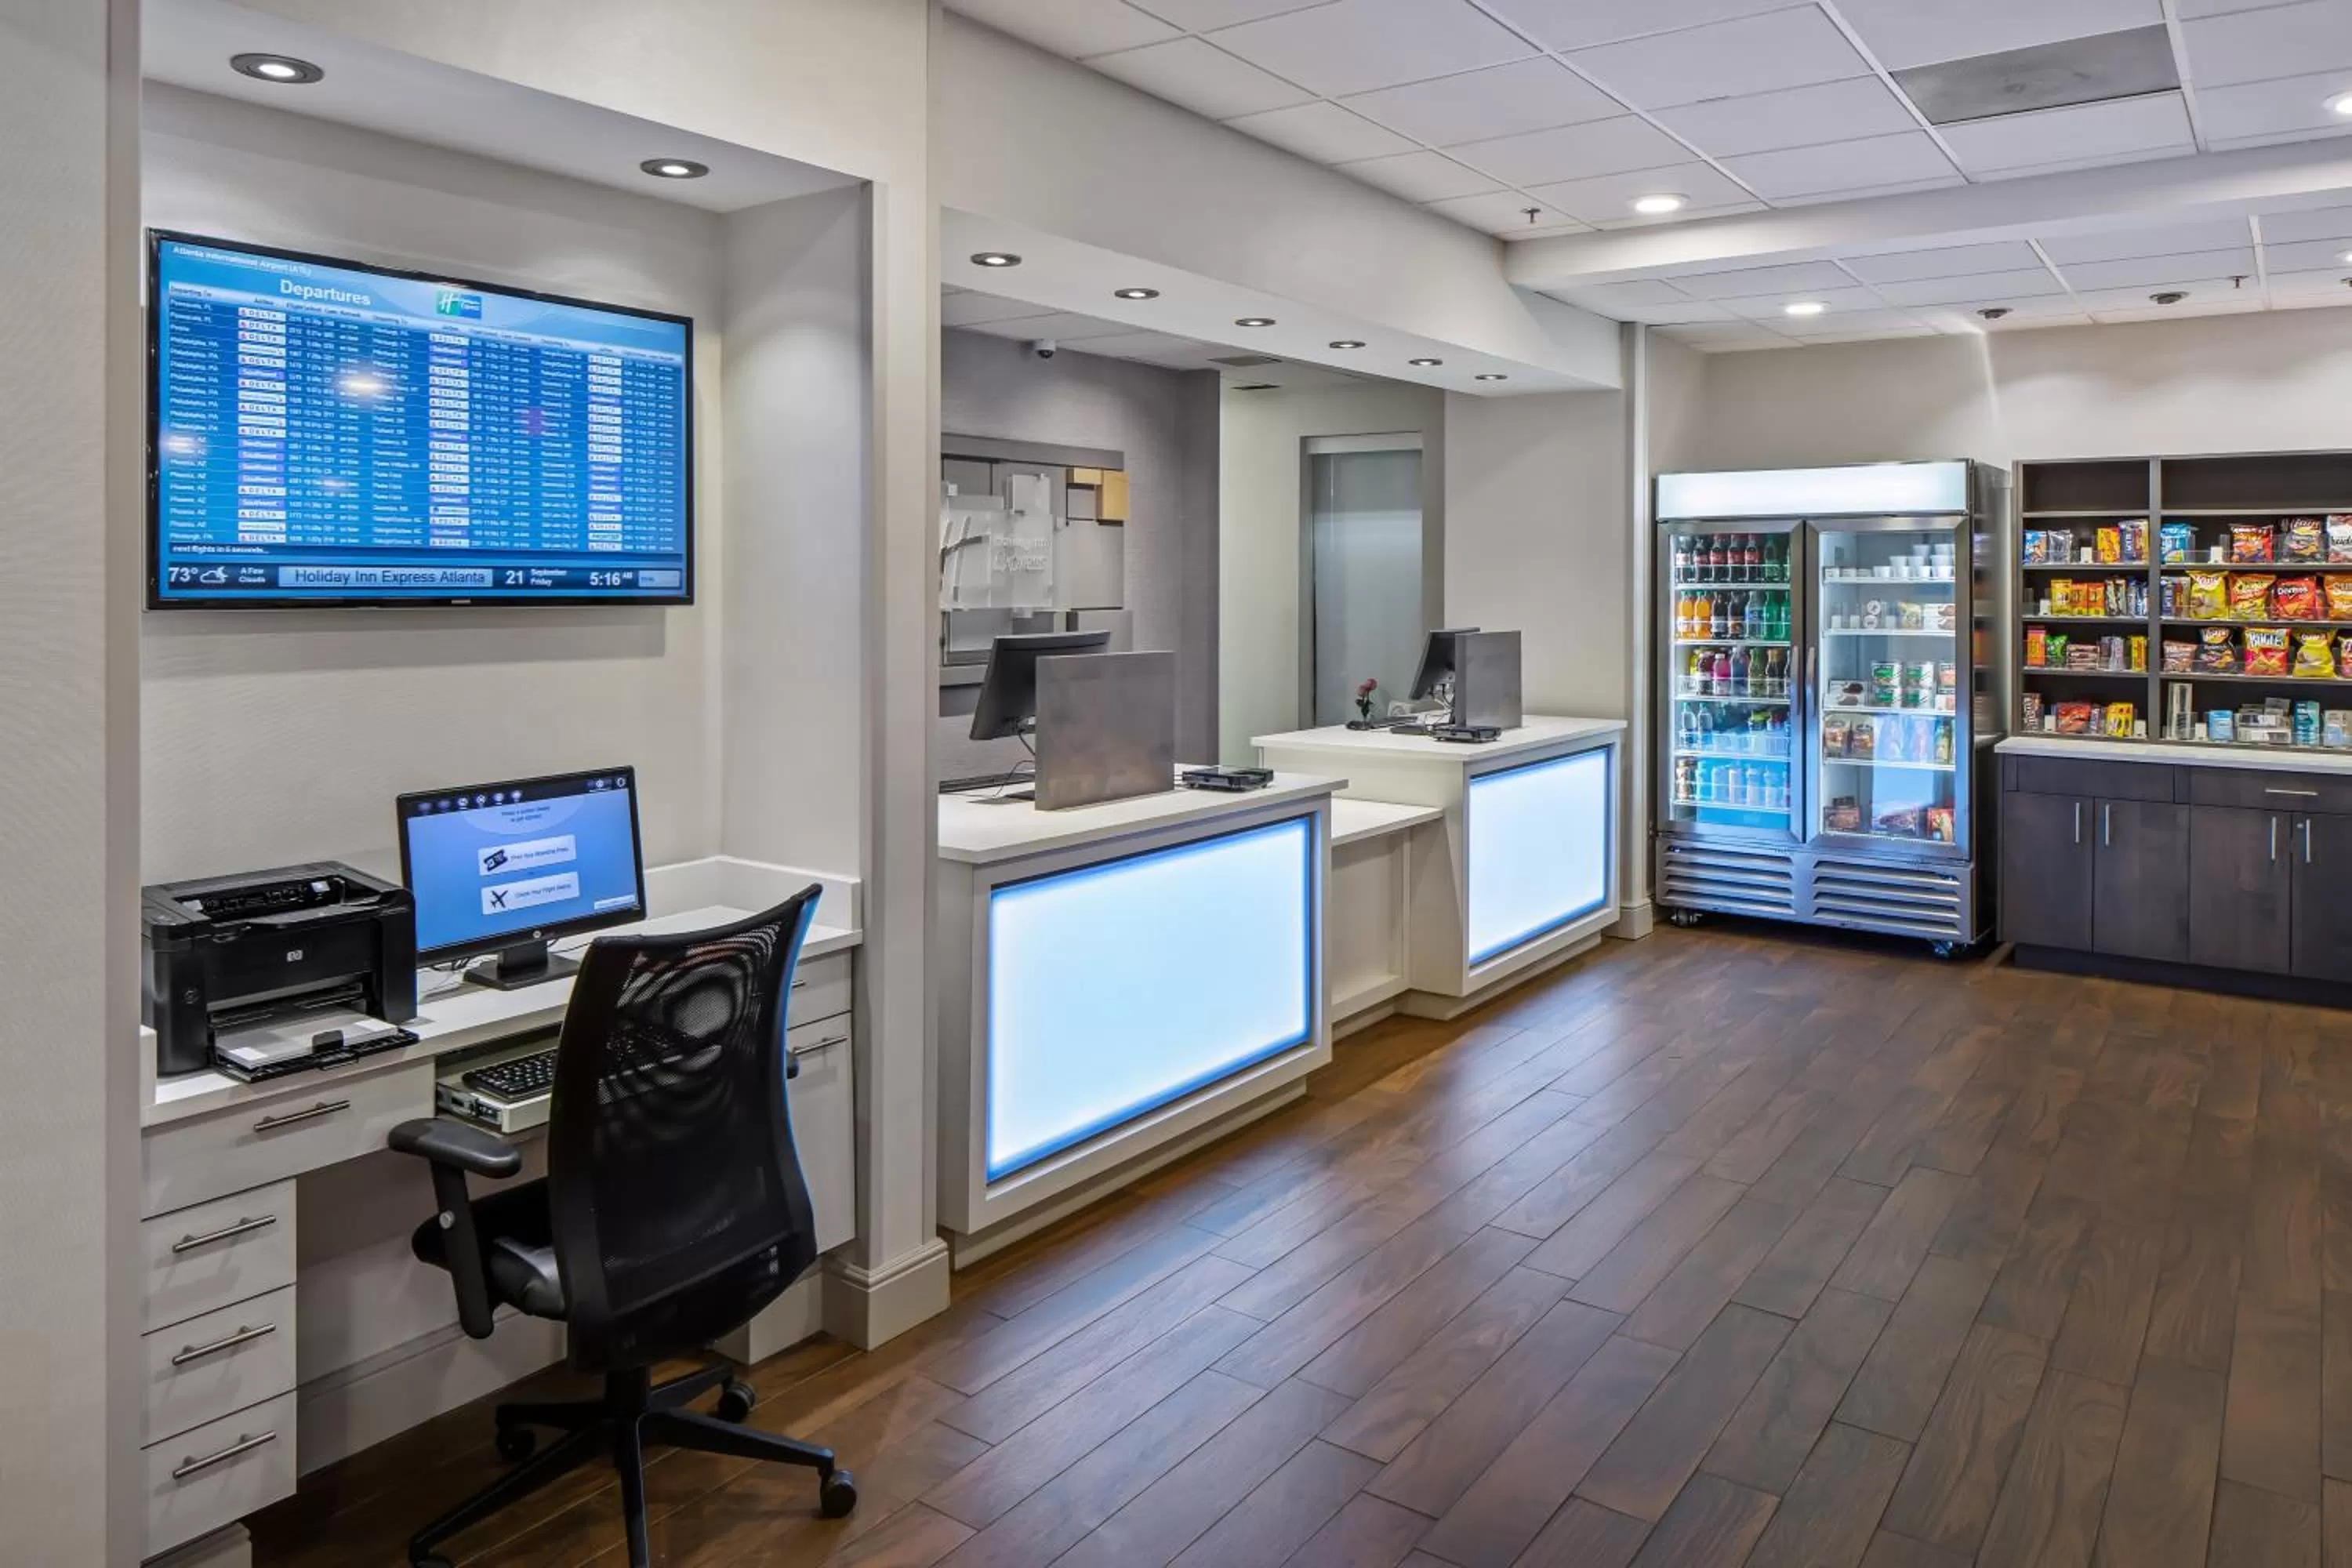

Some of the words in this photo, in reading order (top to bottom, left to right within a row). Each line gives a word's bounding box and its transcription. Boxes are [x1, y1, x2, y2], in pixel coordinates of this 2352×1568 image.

[280, 278, 371, 305] Departures
[295, 569, 350, 585] Holiday
[355, 569, 377, 583] Inn
[382, 571, 434, 586] Express
[440, 571, 485, 583] Atlanta
[505, 570, 524, 585] 21
[530, 578, 552, 587] Friday
[589, 572, 621, 586] 5:16
[2277, 583, 2309, 597] Doritos
